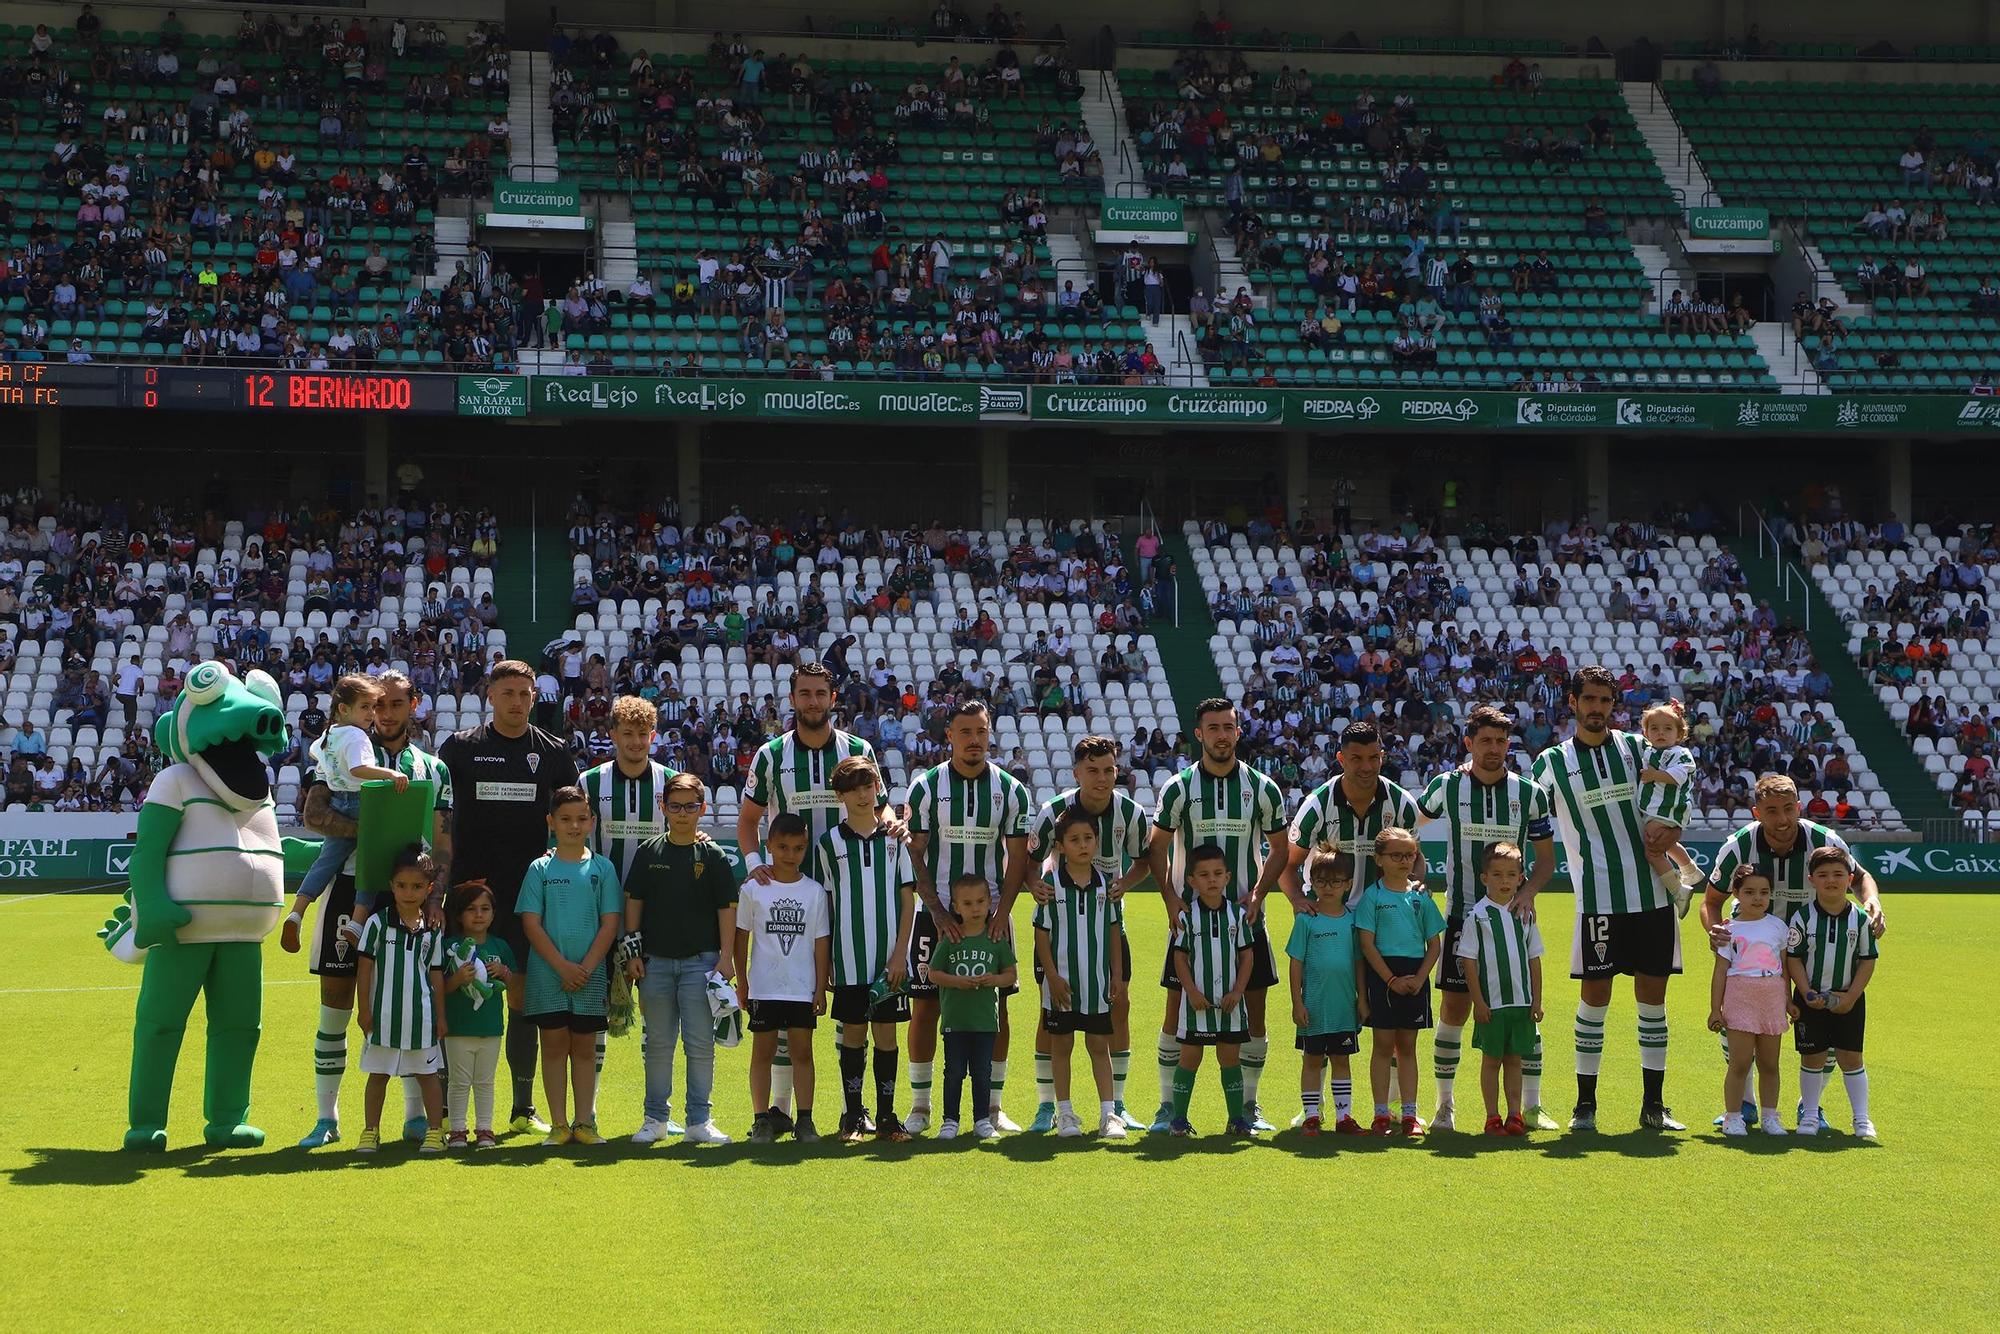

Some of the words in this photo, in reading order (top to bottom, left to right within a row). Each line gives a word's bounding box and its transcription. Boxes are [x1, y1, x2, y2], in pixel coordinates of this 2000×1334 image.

[500, 190, 574, 207] Cruzcampo
[1107, 207, 1177, 223] Cruzcampo
[1695, 216, 1764, 231] Cruzcampo
[24, 365, 47, 381] CF
[145, 368, 157, 384] 0
[35, 388, 58, 404] FC
[144, 391, 158, 407] 0
[245, 375, 274, 406] 12
[289, 376, 411, 409] BERNARDO
[459, 394, 484, 404] SAN
[484, 397, 525, 406] RAFAEL
[1046, 393, 1147, 415] Cruzcampo
[1168, 394, 1267, 416] Cruzcampo
[472, 405, 512, 415] MOTOR
[1548, 403, 1596, 413] Diputación
[1646, 404, 1695, 414] Diputación
[1762, 404, 1807, 413] AYUNTAMIENTO
[1862, 404, 1907, 413] AYUNTAMIENTO
[1547, 413, 1558, 421] de
[1560, 413, 1596, 422] Córdoba
[1646, 414, 1658, 422] de
[1659, 414, 1695, 423] Córdoba
[1761, 413, 1770, 421] DE
[1861, 413, 1870, 422] DE
[474, 755, 505, 763] GIVOVA
[1924, 849, 2000, 873] Caix
[1313, 931, 1338, 939] GIVOVA
[1587, 916, 1609, 941] 12
[918, 936, 931, 962] 5
[949, 950, 994, 965] SILBON
[1587, 962, 1614, 971] GIVOVA
